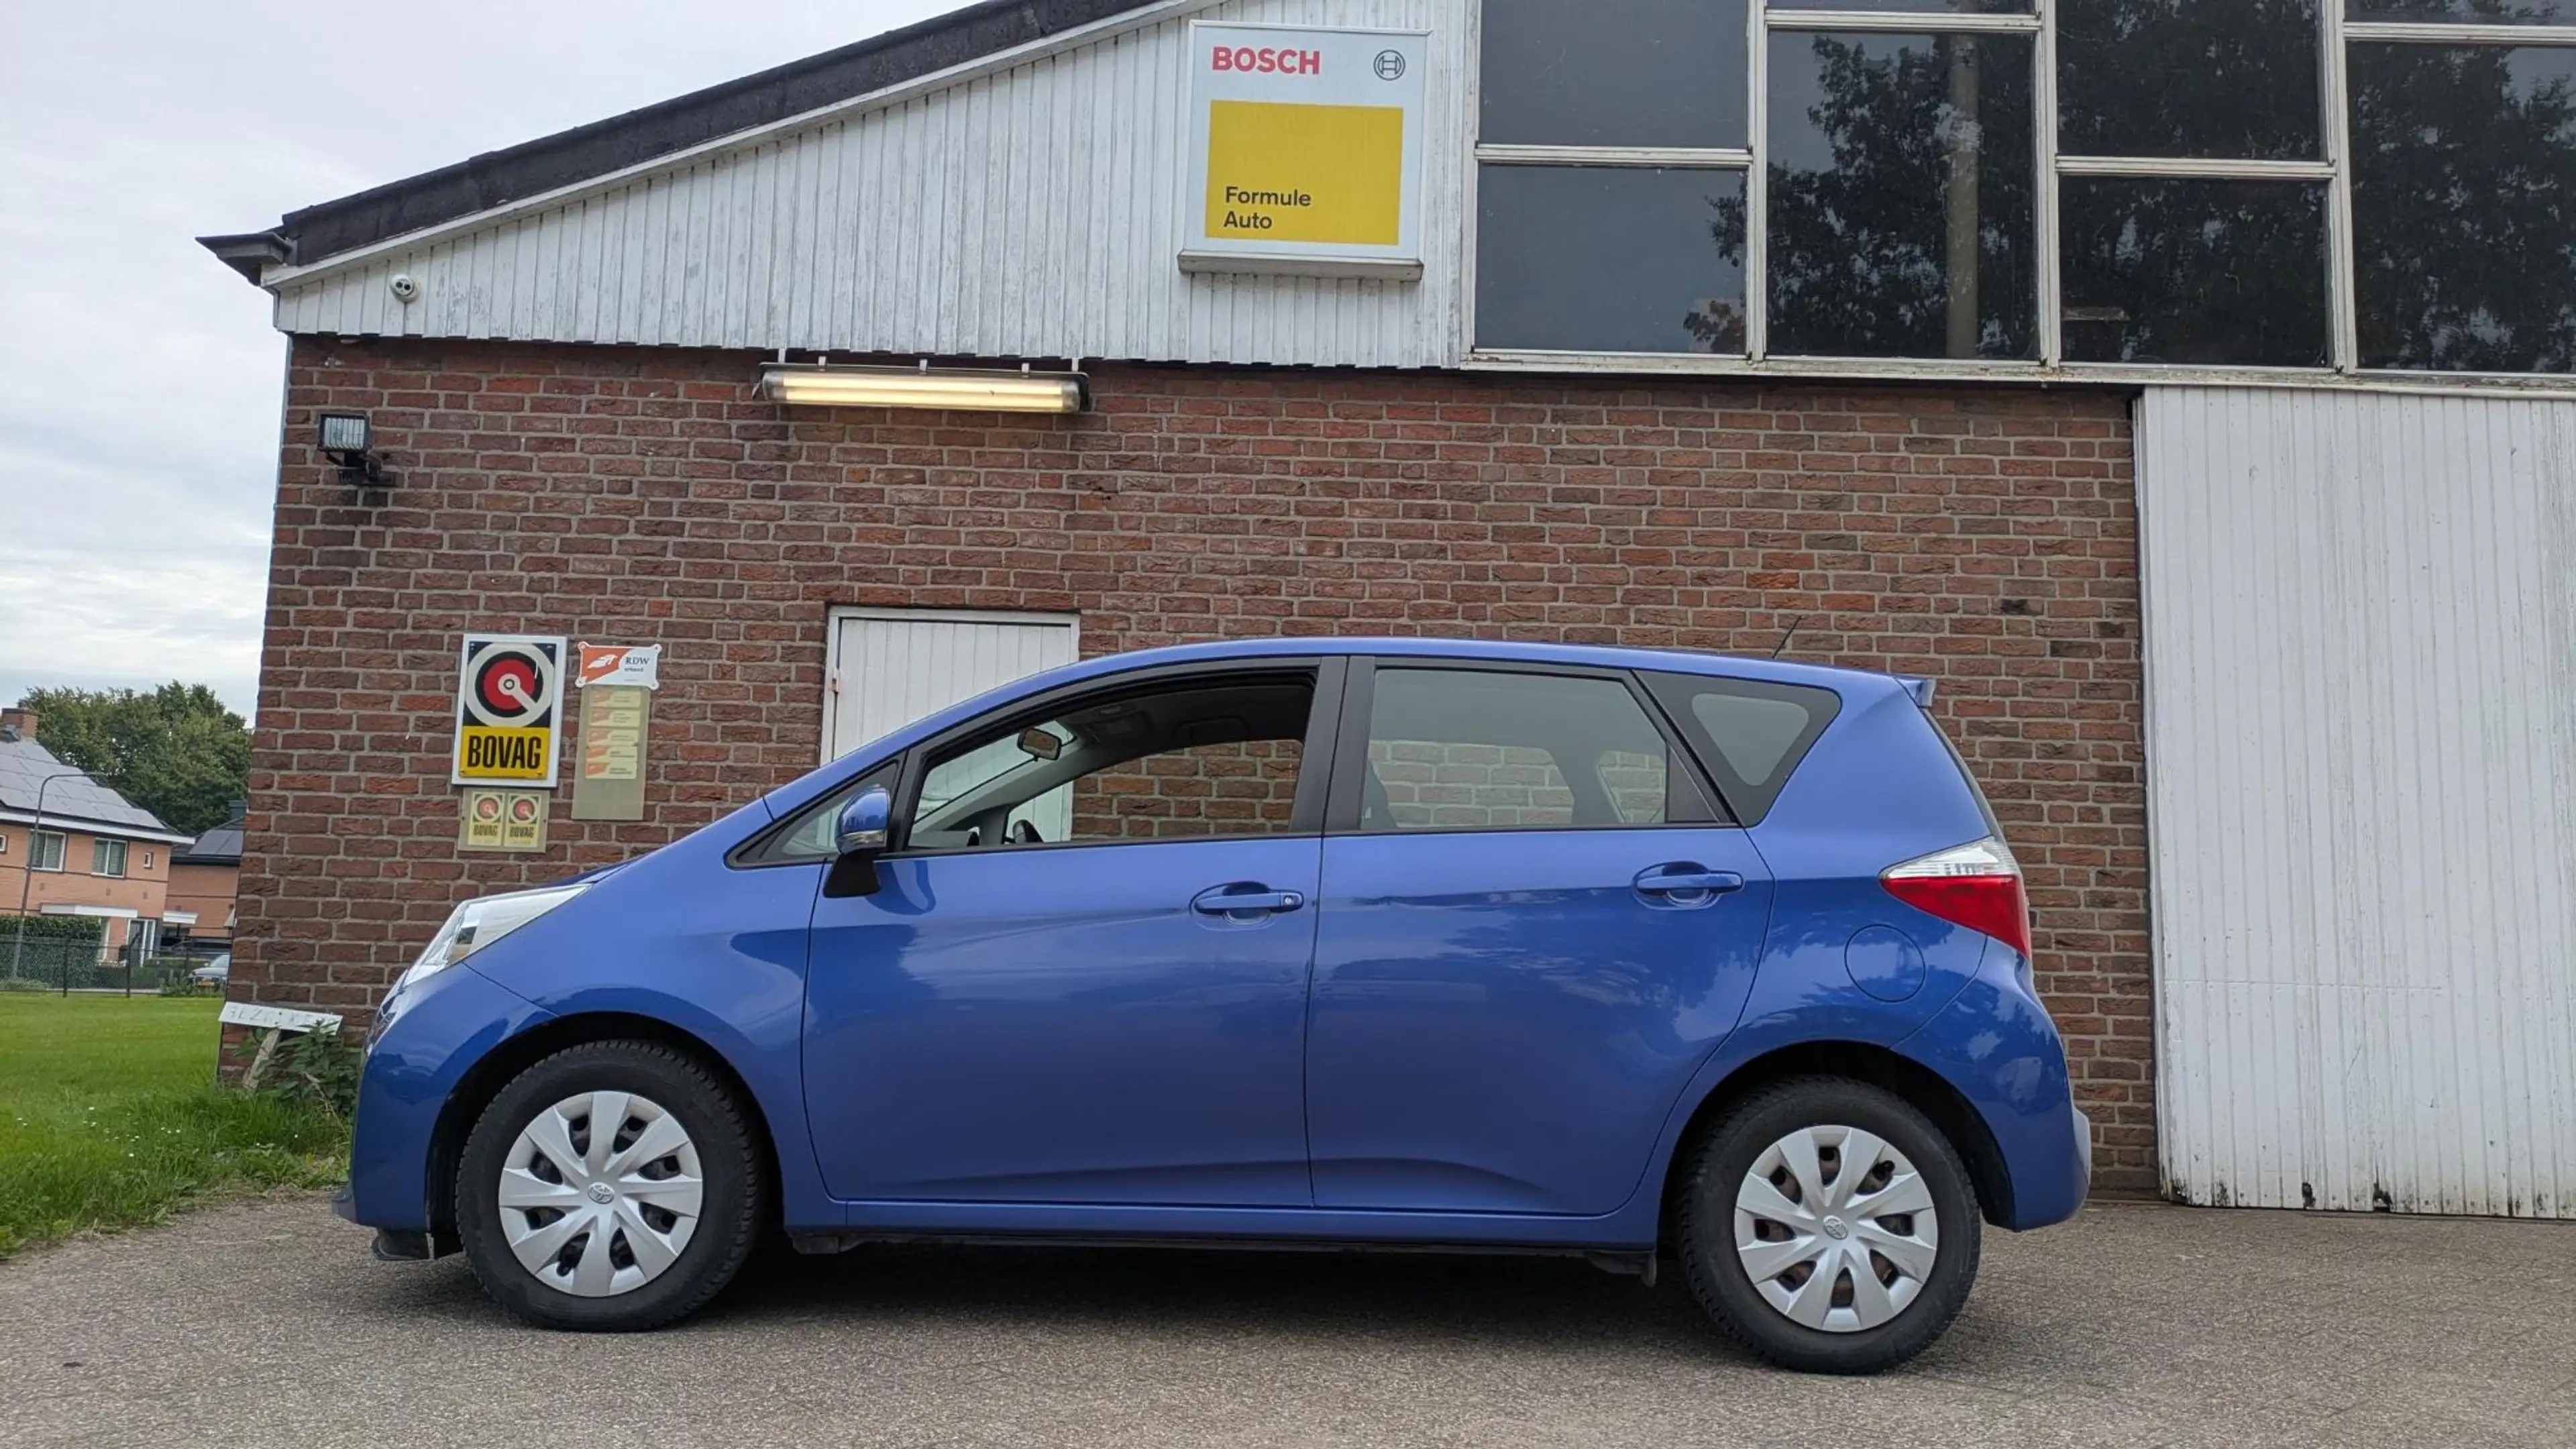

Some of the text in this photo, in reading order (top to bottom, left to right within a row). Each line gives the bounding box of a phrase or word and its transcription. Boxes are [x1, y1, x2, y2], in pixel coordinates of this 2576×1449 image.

[1212, 46, 1320, 74] BOSCH
[1226, 186, 1311, 207] Formule
[1224, 211, 1273, 229] Auto
[625, 657, 650, 665] RDW
[467, 735, 542, 769] BOVAG
[474, 824, 498, 837] BOVAG
[509, 826, 535, 838] BOVAG
